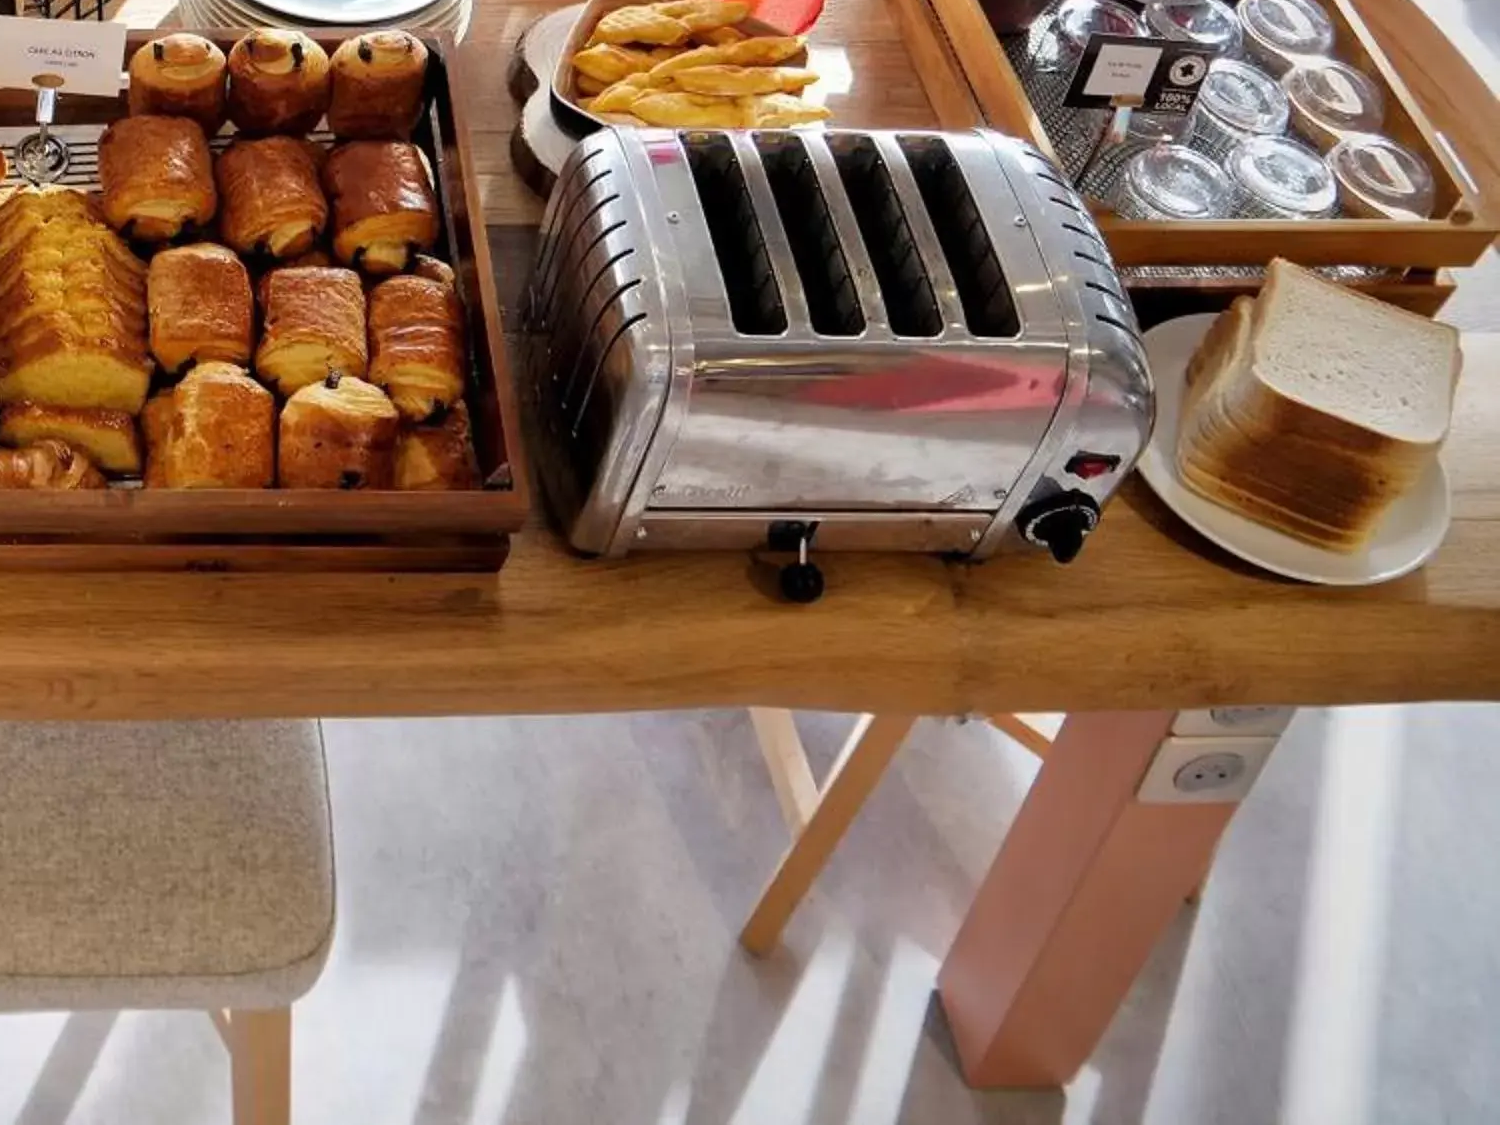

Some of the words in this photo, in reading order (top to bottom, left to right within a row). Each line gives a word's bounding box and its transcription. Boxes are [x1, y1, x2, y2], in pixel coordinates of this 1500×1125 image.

[65, 48, 96, 59] CITRON
[1159, 92, 1192, 104] 100%
[1154, 102, 1187, 112] LOCAL
